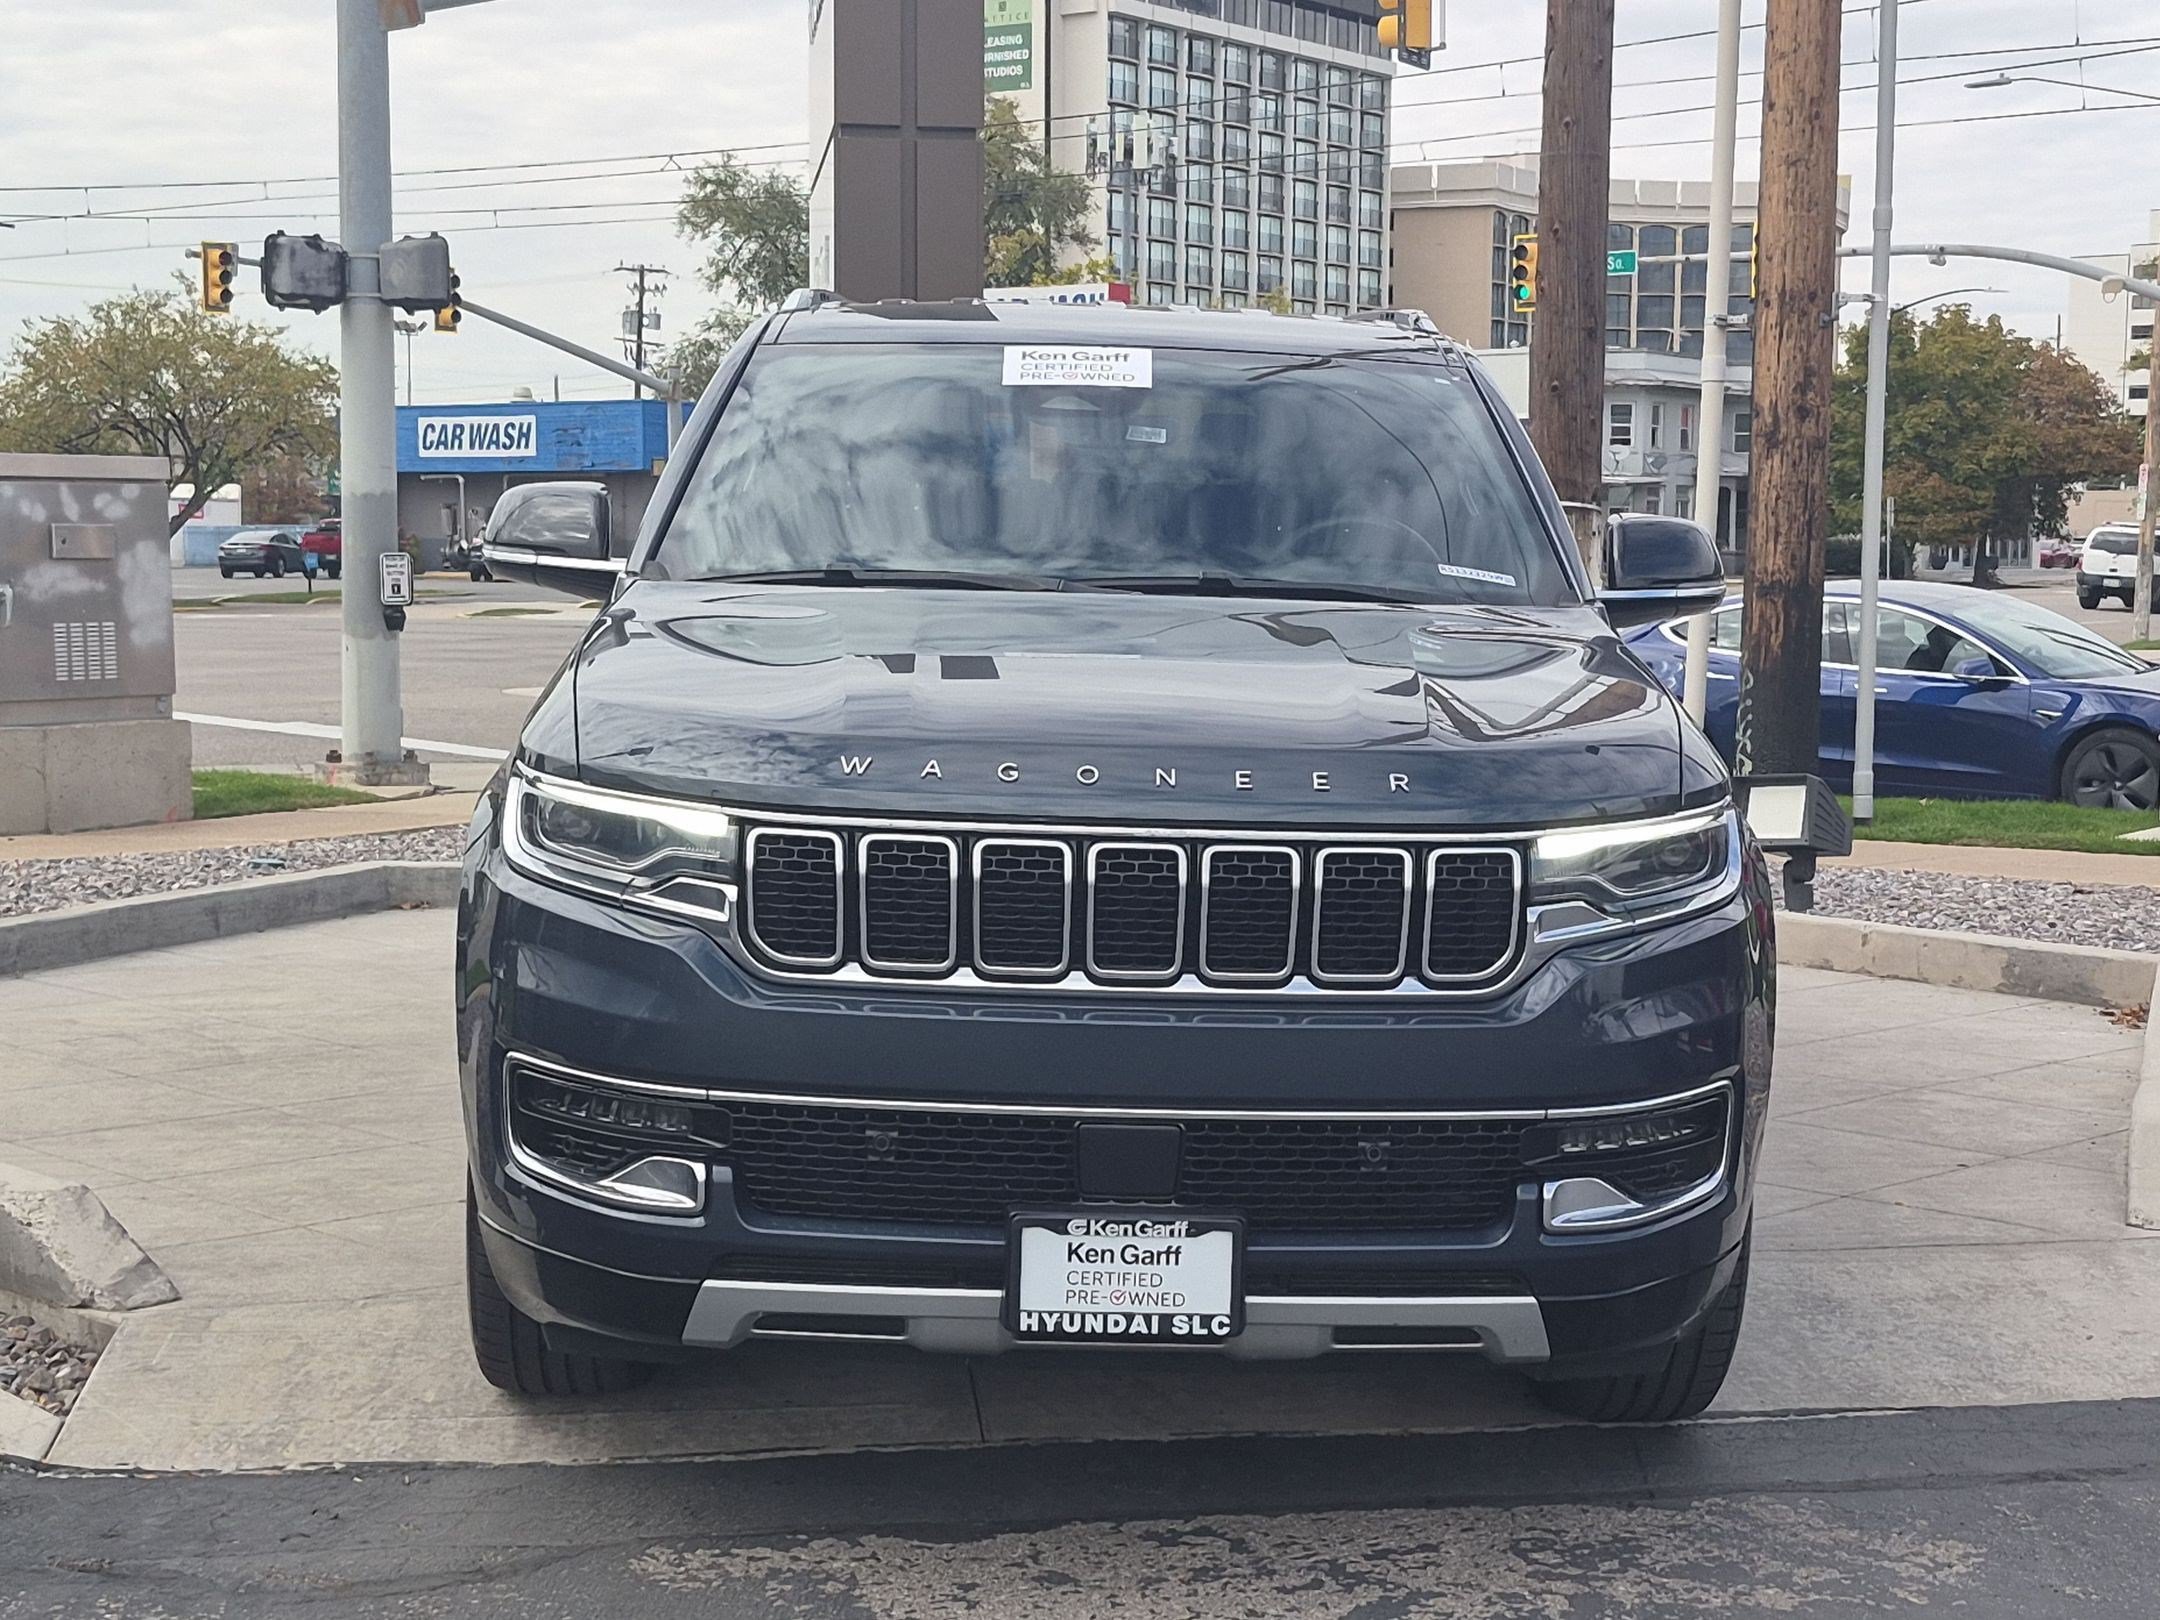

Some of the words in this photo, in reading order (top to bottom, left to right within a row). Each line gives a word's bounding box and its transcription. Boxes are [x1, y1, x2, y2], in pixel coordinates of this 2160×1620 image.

[1020, 362, 1113, 372] CERTIFIED
[1021, 350, 1067, 361] Ken
[1071, 351, 1130, 363] Garff
[422, 423, 466, 451] CAR
[468, 421, 533, 451] WASH
[838, 754, 1412, 793] WAGONEER
[1066, 1242, 1116, 1264] Ken
[1119, 1243, 1182, 1267] Garff
[1066, 1270, 1164, 1288] CERTIFIED
[1019, 1311, 1160, 1335] HYUNDAI
[1171, 1315, 1232, 1336] SLC
